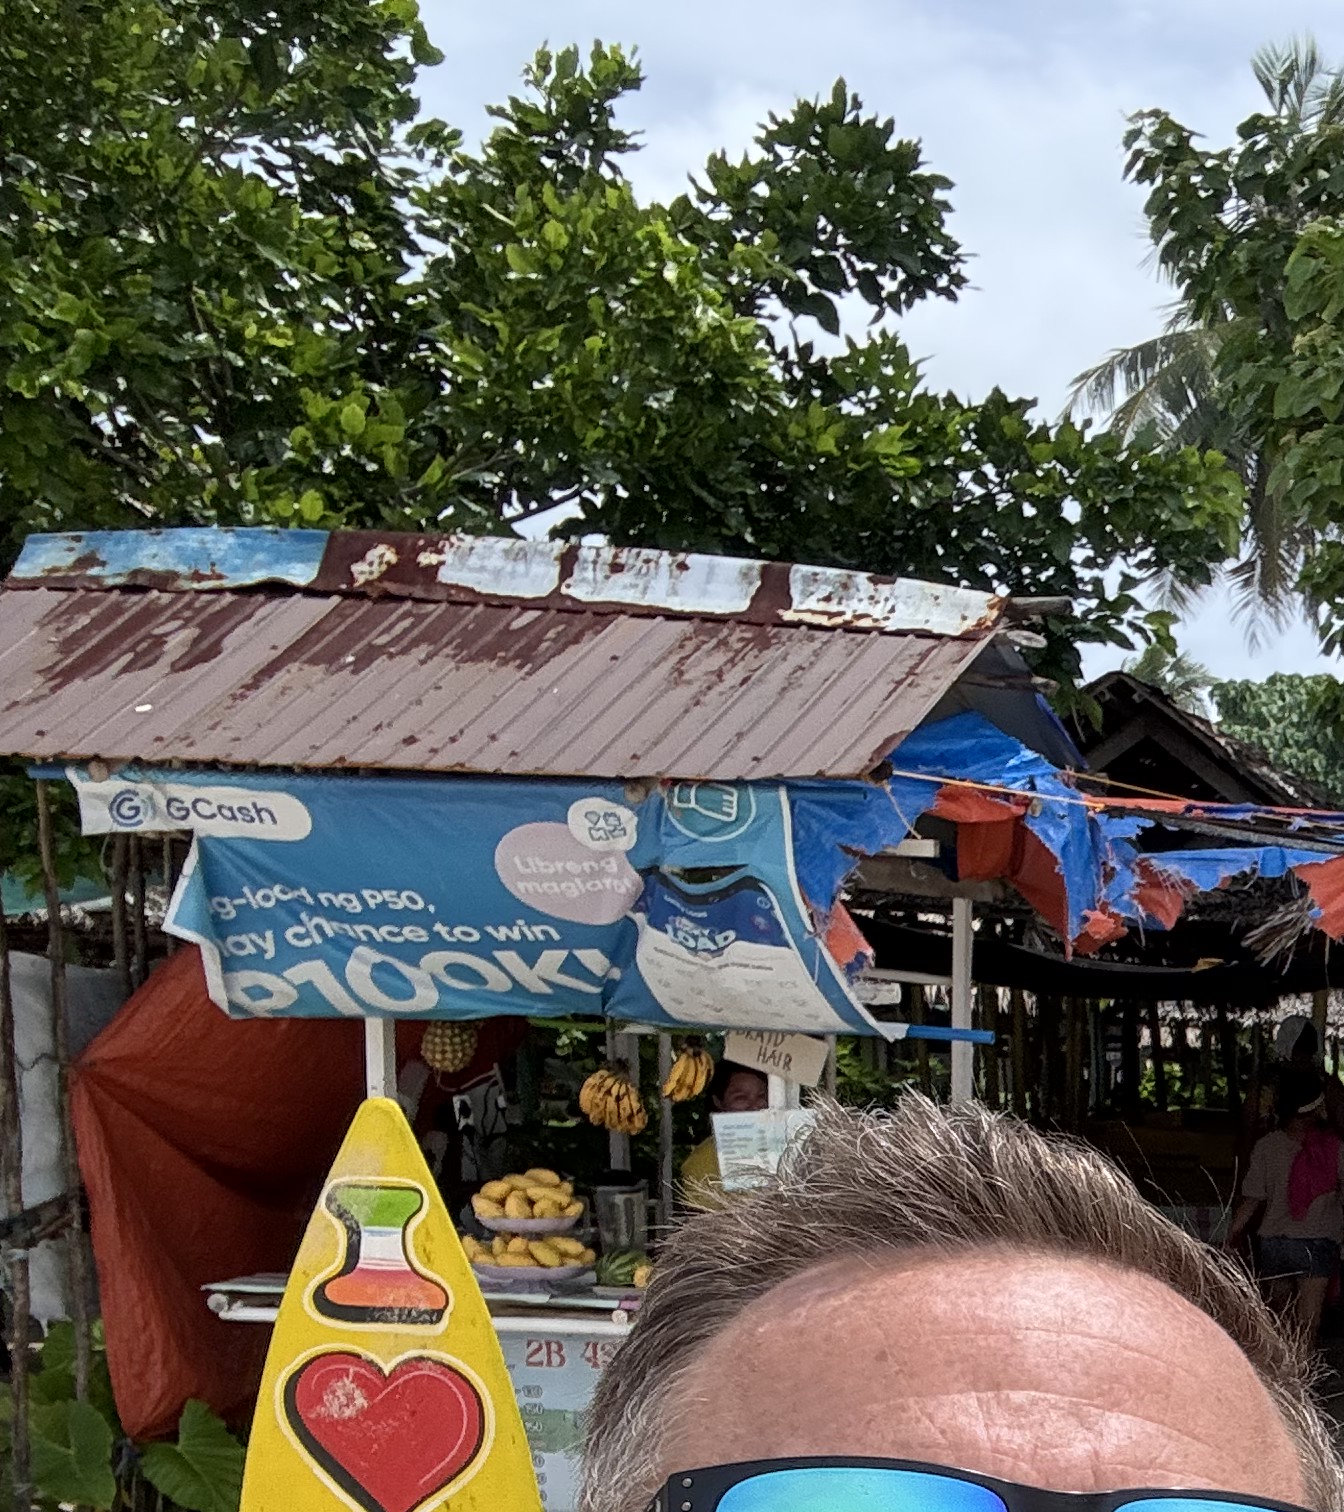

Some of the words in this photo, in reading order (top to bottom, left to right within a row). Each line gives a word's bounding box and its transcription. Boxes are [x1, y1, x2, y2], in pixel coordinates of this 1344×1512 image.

[166, 797, 278, 826] GCash
[317, 891, 363, 914] ng
[284, 911, 430, 948] chance
[433, 920, 481, 943] to
[488, 919, 561, 943] win
[757, 1045, 793, 1072] HAIR
